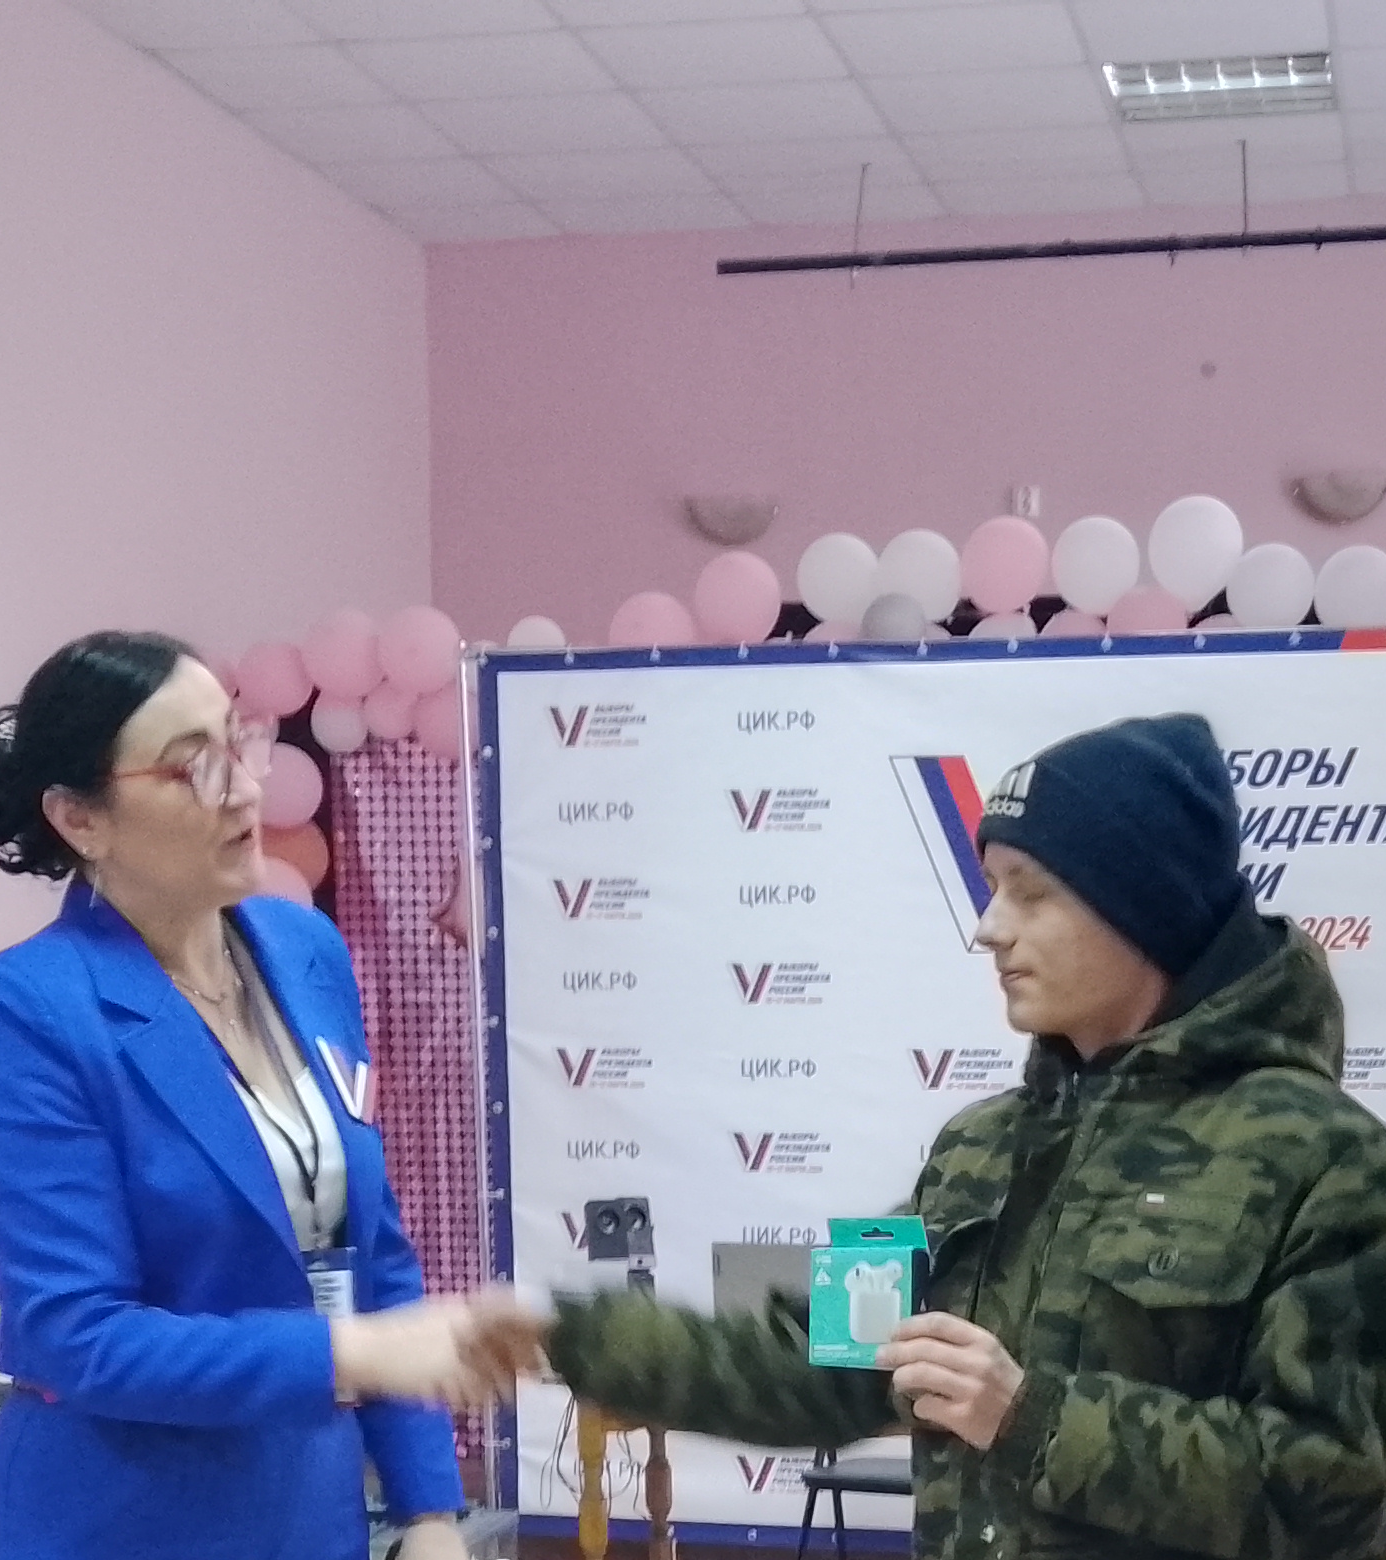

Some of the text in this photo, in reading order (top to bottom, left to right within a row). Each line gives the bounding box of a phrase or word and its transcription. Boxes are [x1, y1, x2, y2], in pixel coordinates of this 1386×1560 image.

[738, 709, 815, 735] ЦИК.РФ
[1226, 747, 1359, 788] БОРЫ
[559, 801, 634, 825] ЦИК.РФ
[740, 884, 816, 908] ЦИК.РФ
[563, 970, 637, 994] ЦИК.РФ
[741, 1058, 816, 1081] ЦИК.РФ
[567, 1140, 640, 1162] ЦИК.РФ
[743, 1226, 817, 1245] ЦИКРФ
